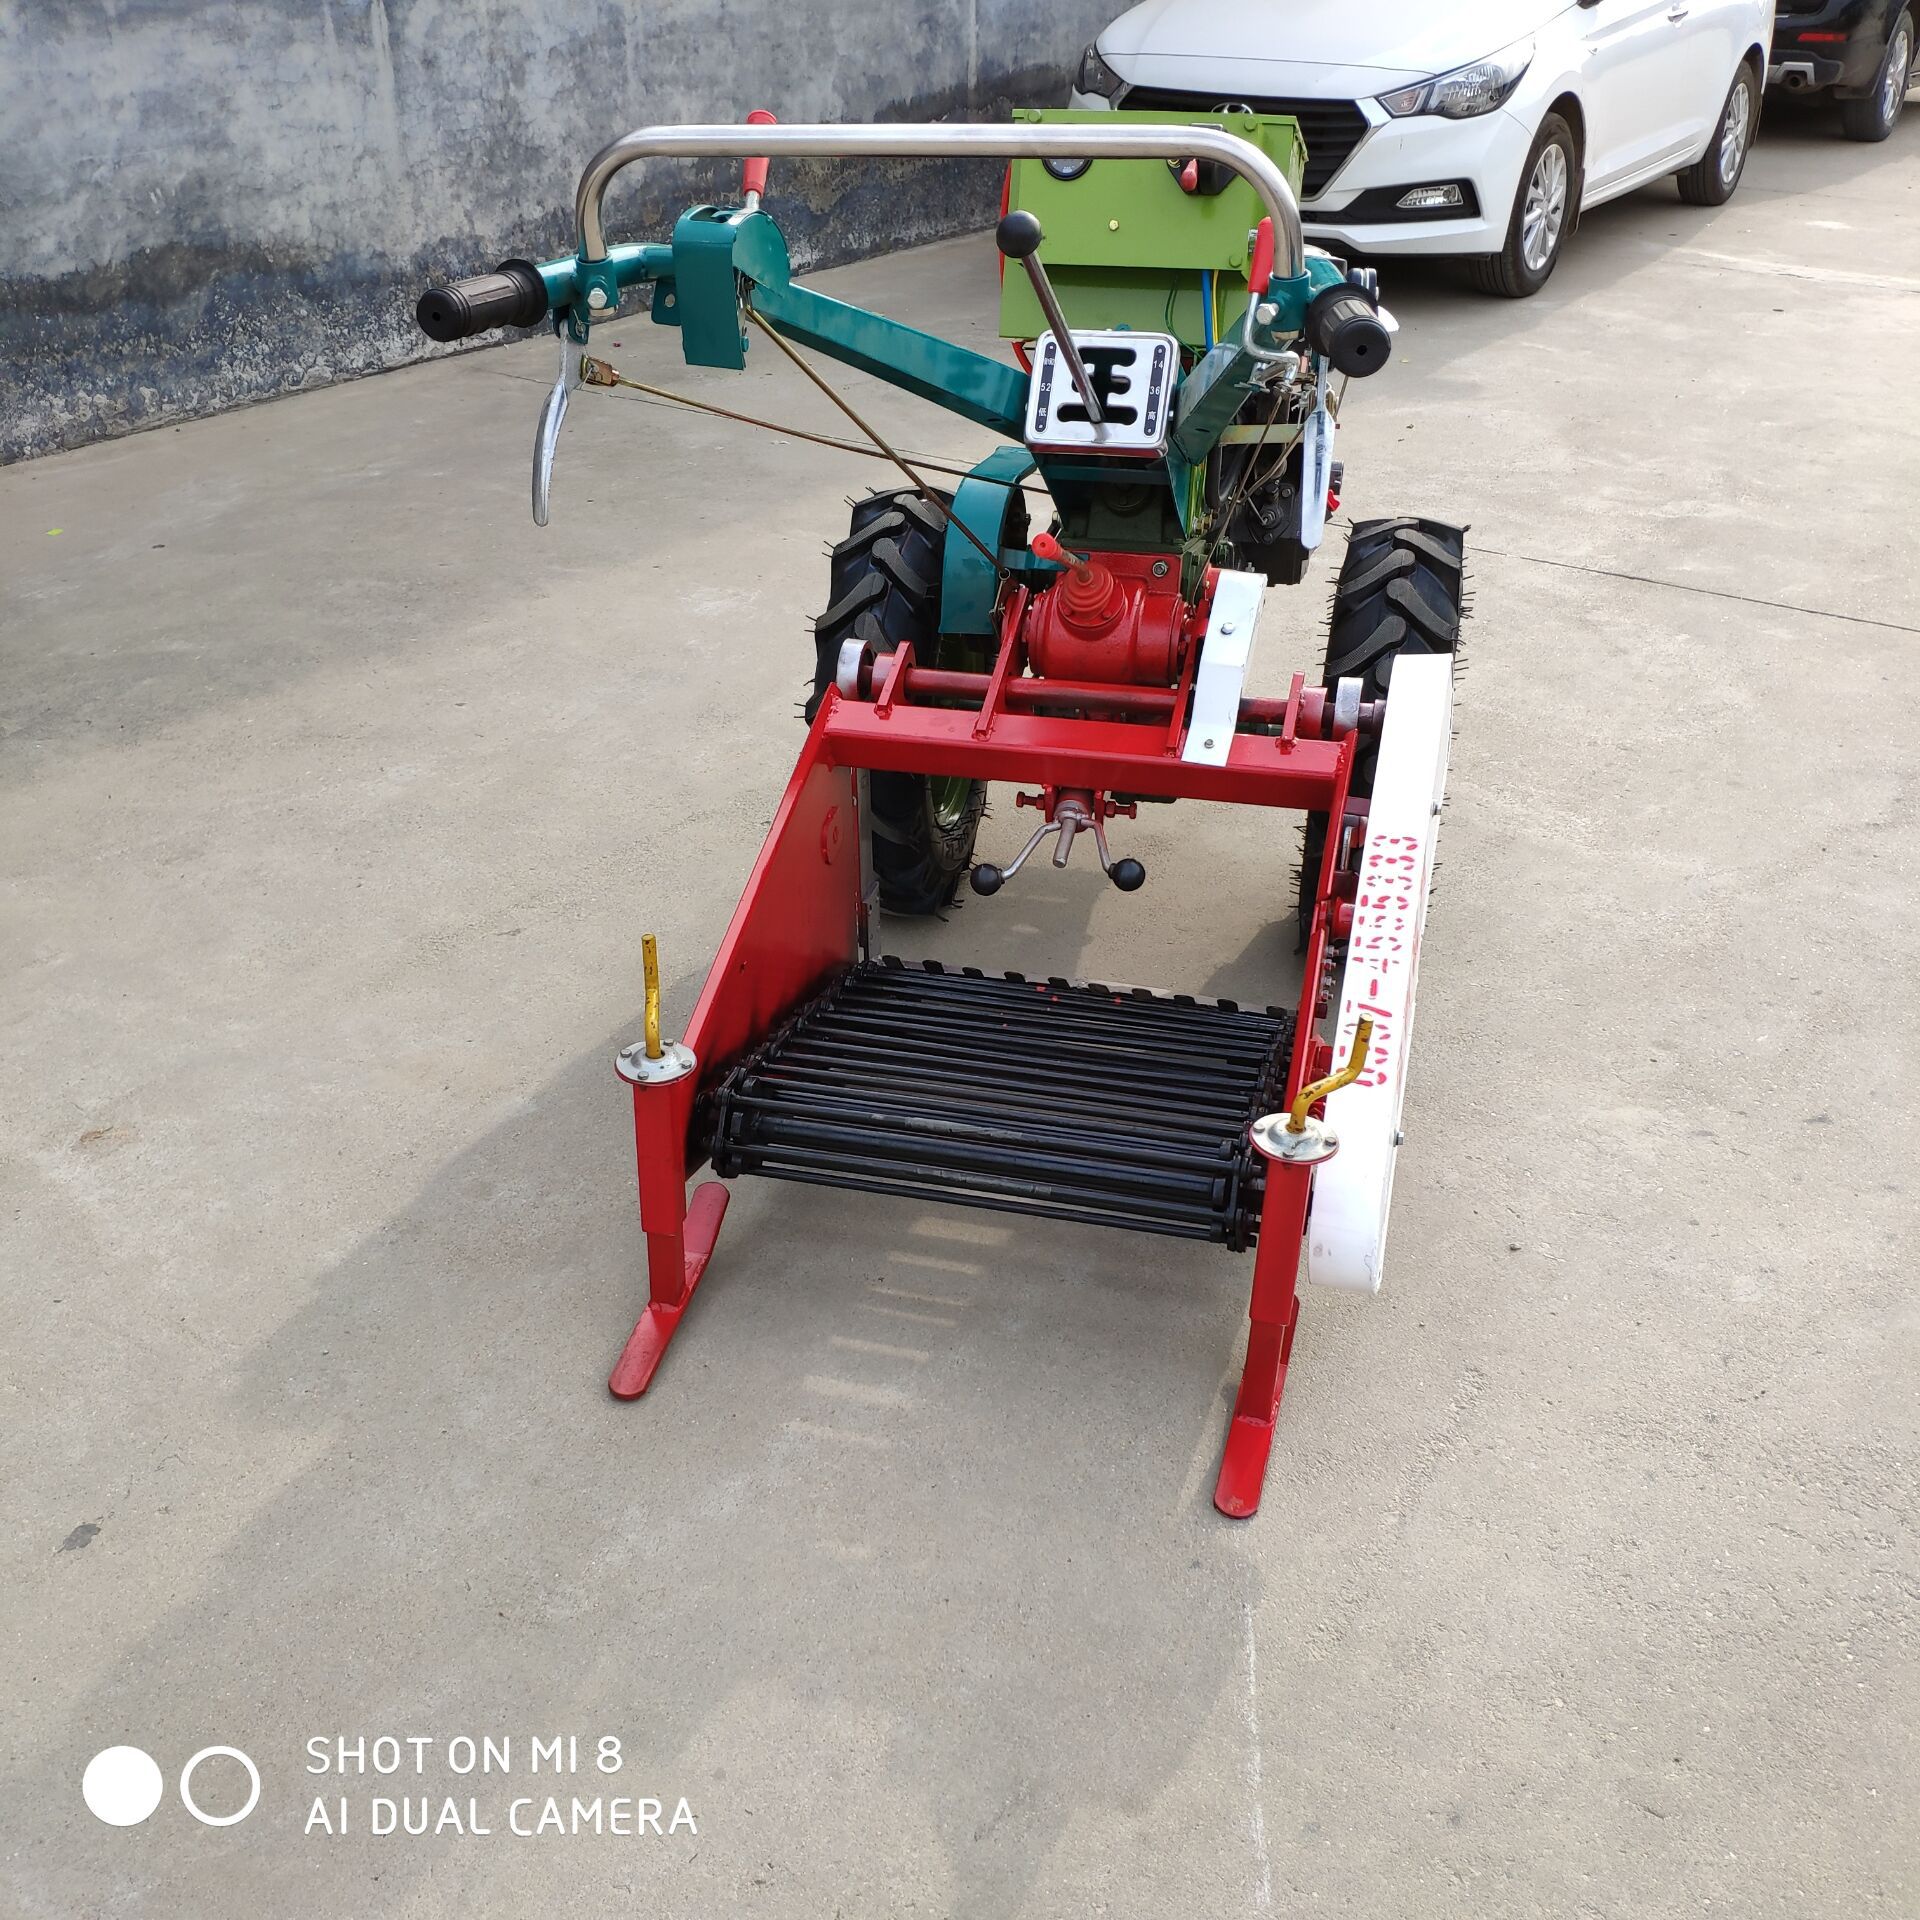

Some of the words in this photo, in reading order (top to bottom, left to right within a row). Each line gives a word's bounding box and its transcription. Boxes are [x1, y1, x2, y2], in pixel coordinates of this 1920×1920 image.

[1153, 360, 1163, 369] 14
[1040, 382, 1051, 392] 52
[1149, 386, 1160, 395] 36
